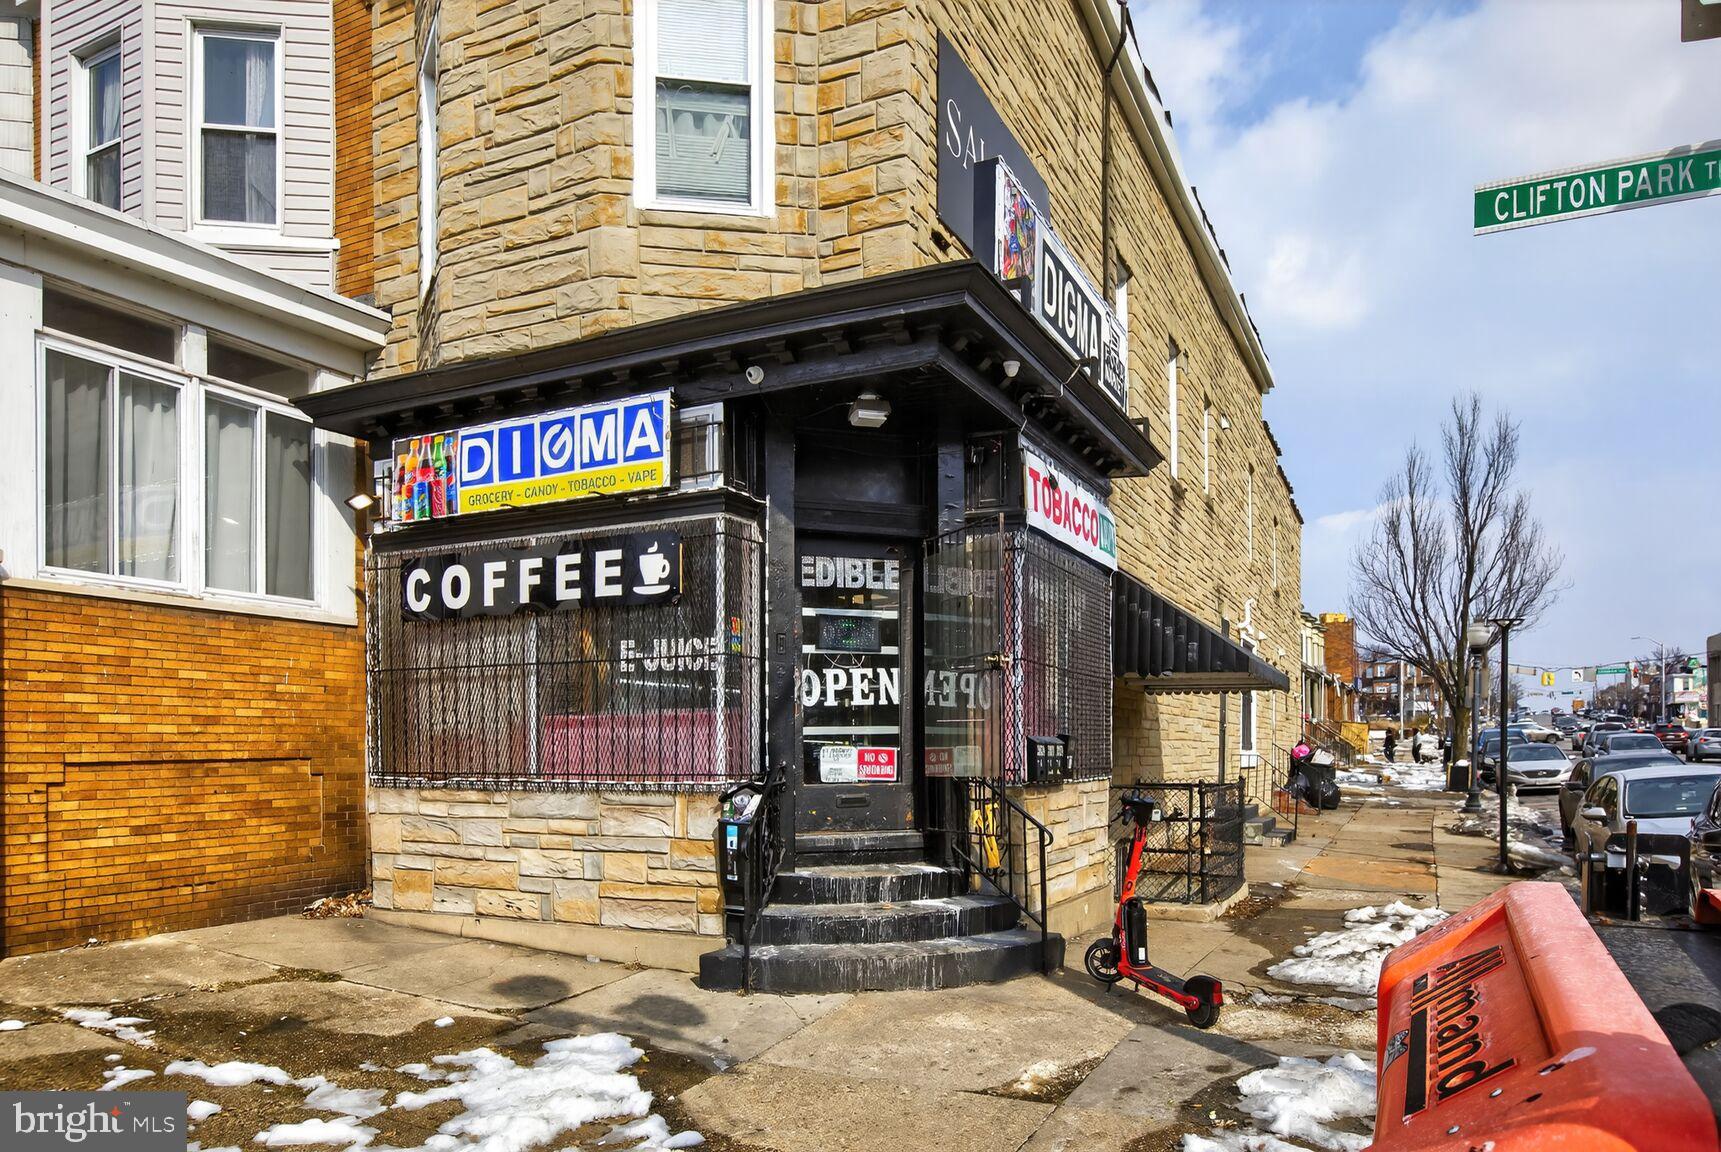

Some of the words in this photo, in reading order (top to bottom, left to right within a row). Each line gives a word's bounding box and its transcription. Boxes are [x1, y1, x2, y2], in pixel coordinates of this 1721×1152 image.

[1494, 175, 1605, 221] CLIFTON
[1618, 159, 1695, 200] PARK
[1704, 160, 1721, 180] T
[1043, 250, 1101, 373] DIGMA
[468, 489, 515, 506] GROCERY
[524, 483, 559, 499] CANDY
[567, 474, 617, 492] TOBACCO
[627, 469, 657, 484] VAPE
[1028, 466, 1099, 547] TOBACCO
[406, 549, 623, 613] COFFEE
[801, 556, 899, 590] EDIBLE
[620, 637, 720, 672] E-JUICE
[802, 667, 899, 708] OPEN
[864, 752, 876, 762] NO
